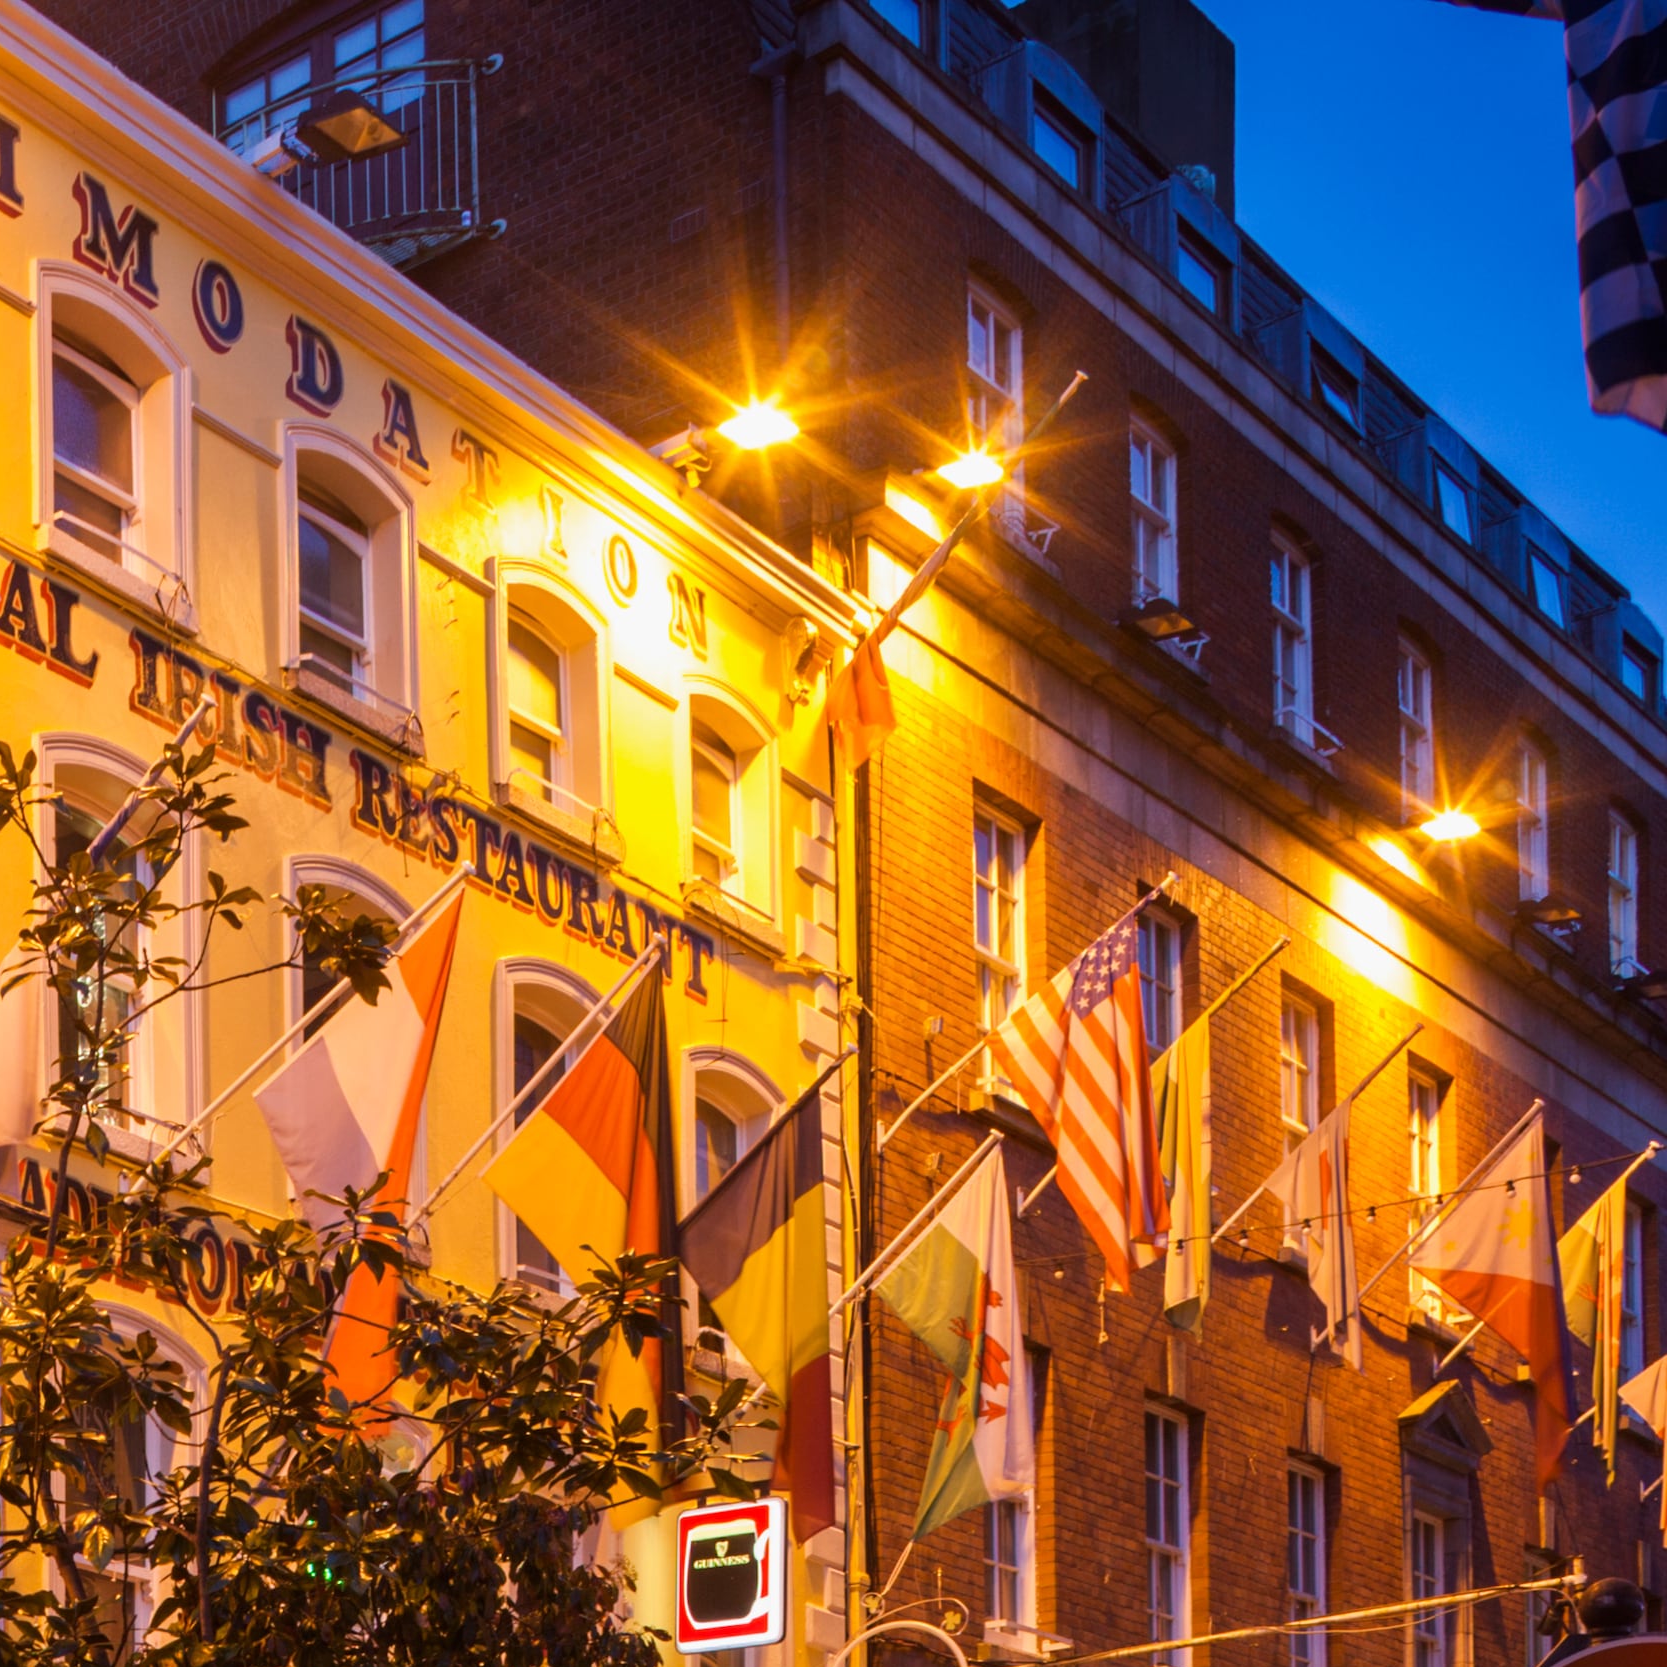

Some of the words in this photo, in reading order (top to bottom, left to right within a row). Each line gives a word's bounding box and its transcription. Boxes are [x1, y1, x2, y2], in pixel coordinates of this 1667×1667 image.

[129, 626, 334, 811] IRISH
[350, 746, 715, 1000] RESTAURANT
[692, 1553, 751, 1571] GUINNESS
